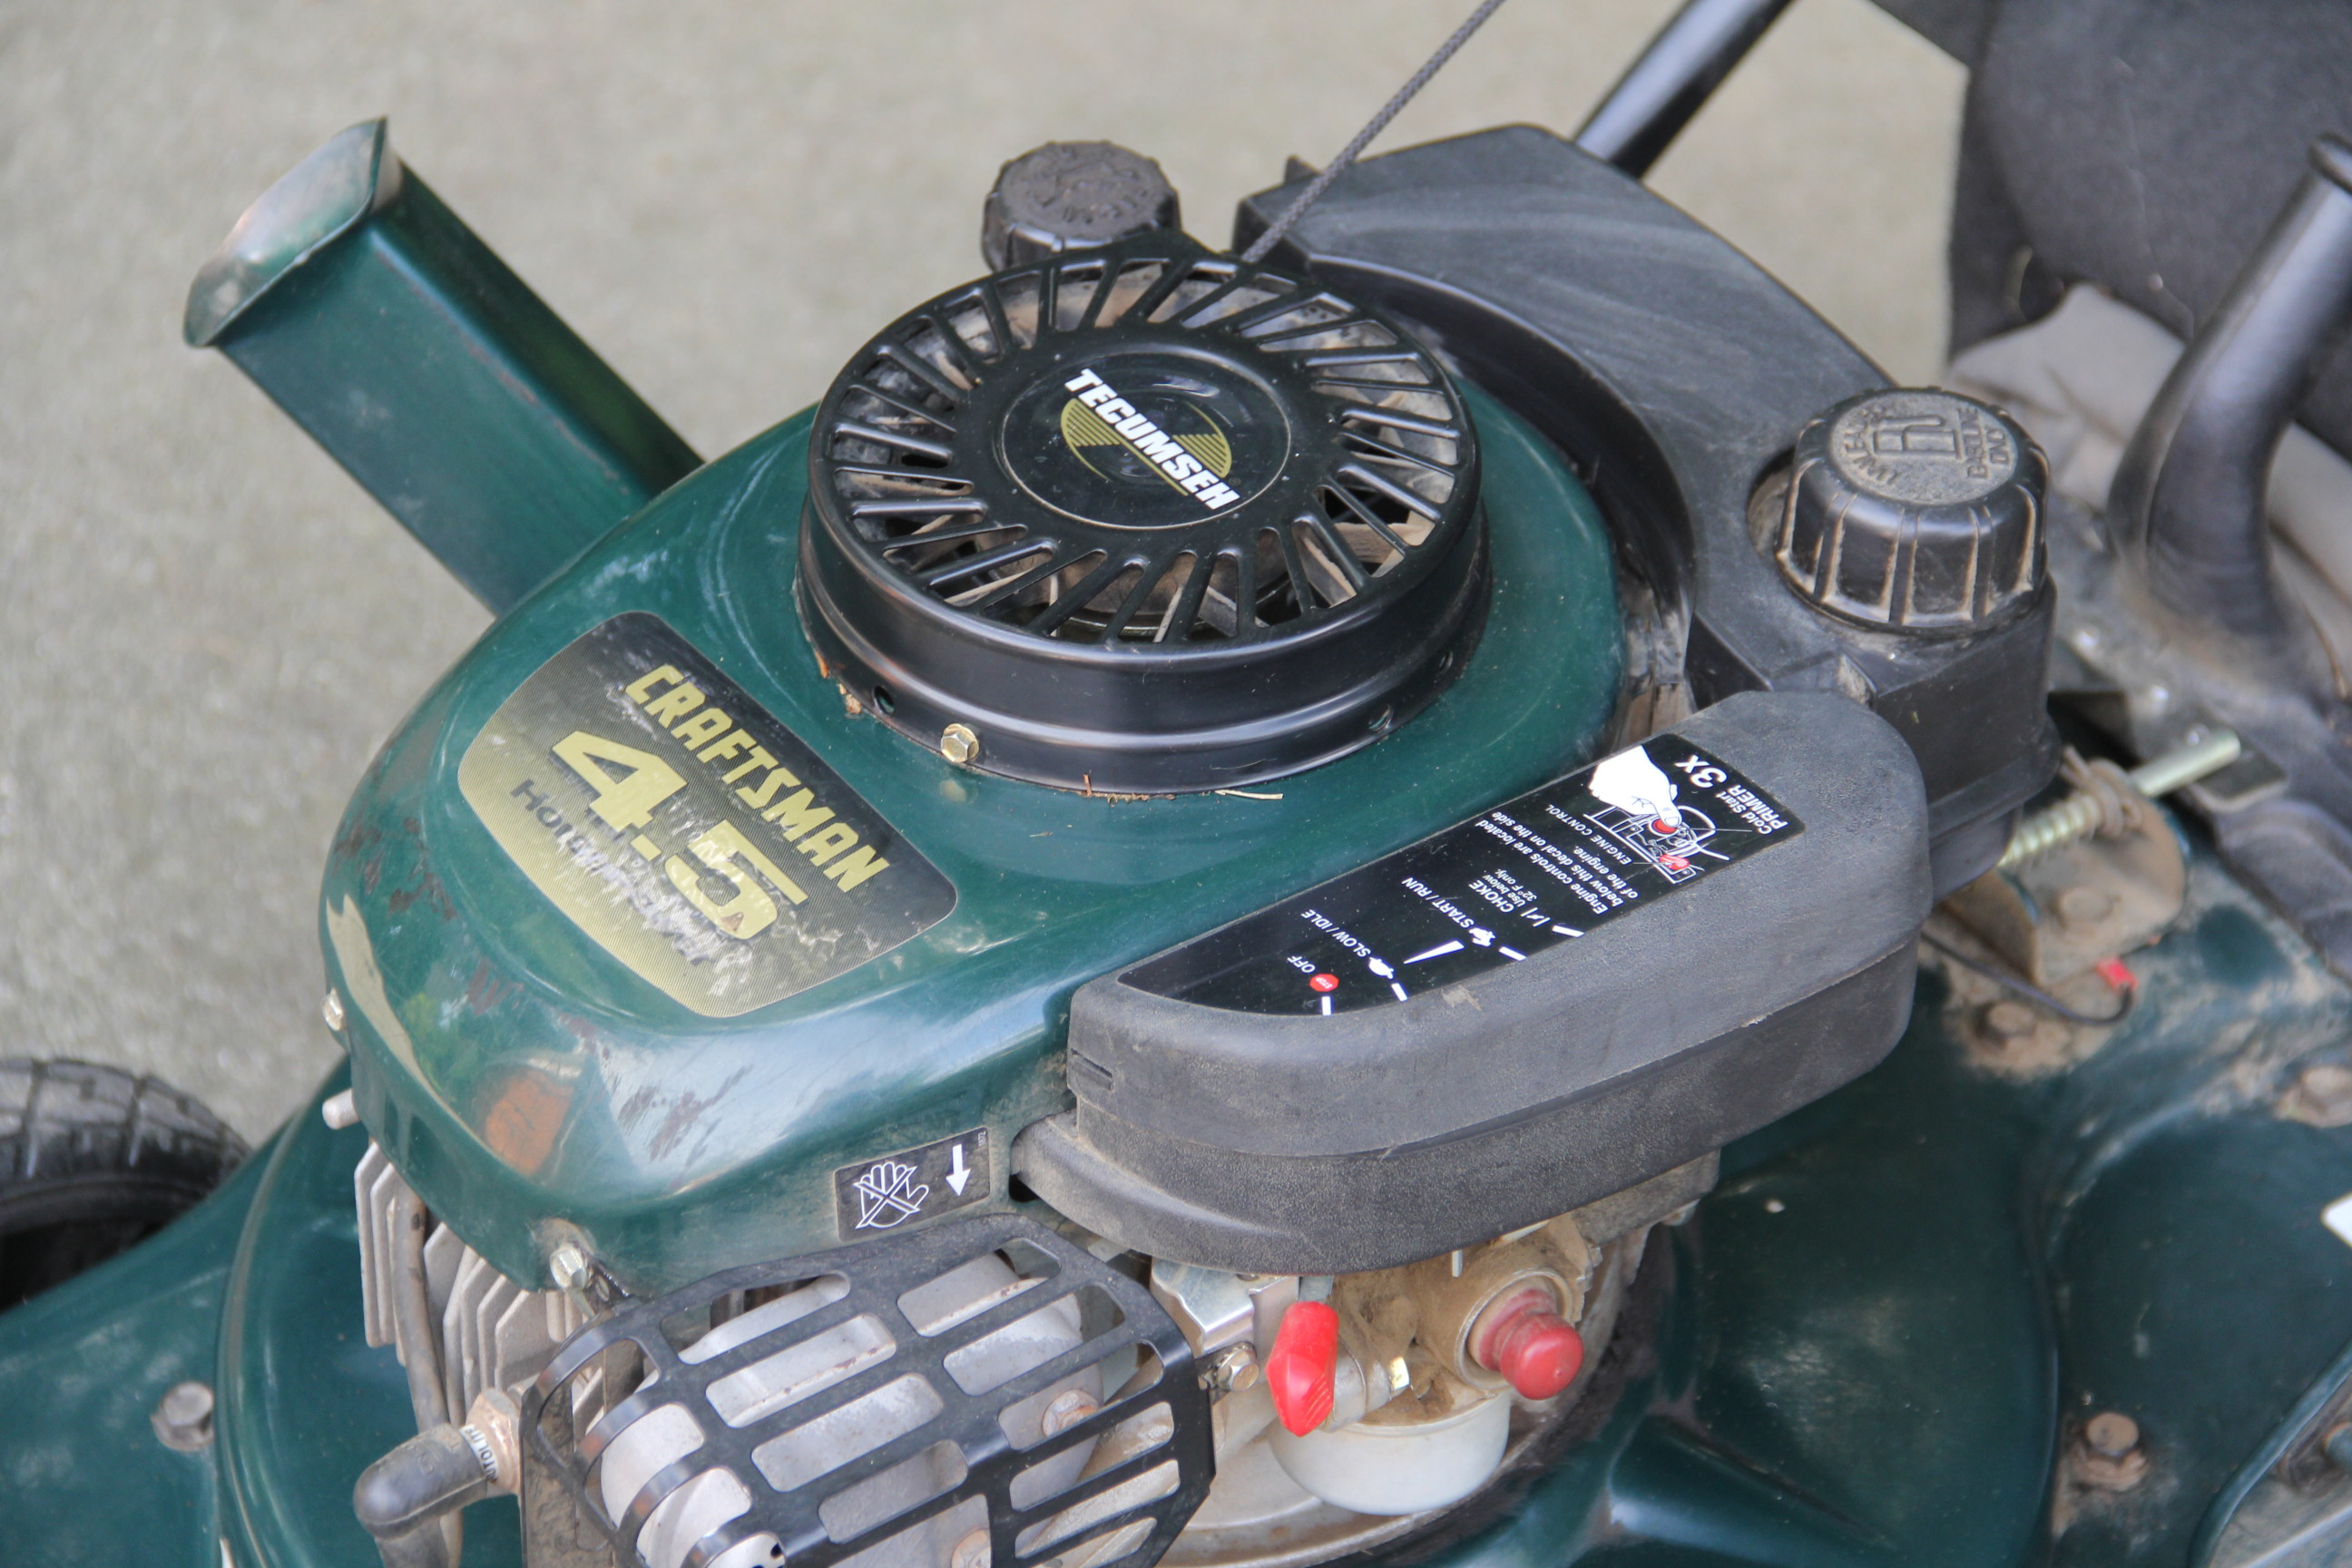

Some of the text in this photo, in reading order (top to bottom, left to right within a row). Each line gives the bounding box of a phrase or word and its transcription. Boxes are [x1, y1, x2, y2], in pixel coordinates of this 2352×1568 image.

[1064, 368, 1240, 510] TECUMSEH
[1957, 407, 1989, 479] GASOLINE
[624, 663, 890, 894] CRAFTSMAN
[1715, 790, 1774, 835] Cold Start
[1727, 784, 1789, 830] PRIMER
[552, 730, 808, 940] 4.5
[1545, 804, 1632, 865] ENGINE CONTROL
[1475, 819, 1609, 915] Engine controls are located
[1492, 811, 1624, 906] below this decal on the side
[1495, 868, 1516, 886] only.
[1573, 845, 1639, 898] of the engine.
[1401, 877, 1433, 897] RUN
[1468, 879, 1515, 913] CHOKE
[1483, 874, 1526, 907] Use below
[1300, 908, 1335, 931] IDLE
[1431, 899, 1475, 928] START
[1287, 955, 1316, 974] OFF
[1331, 930, 1371, 957] SLOW
[1315, 976, 1333, 990] STOP
